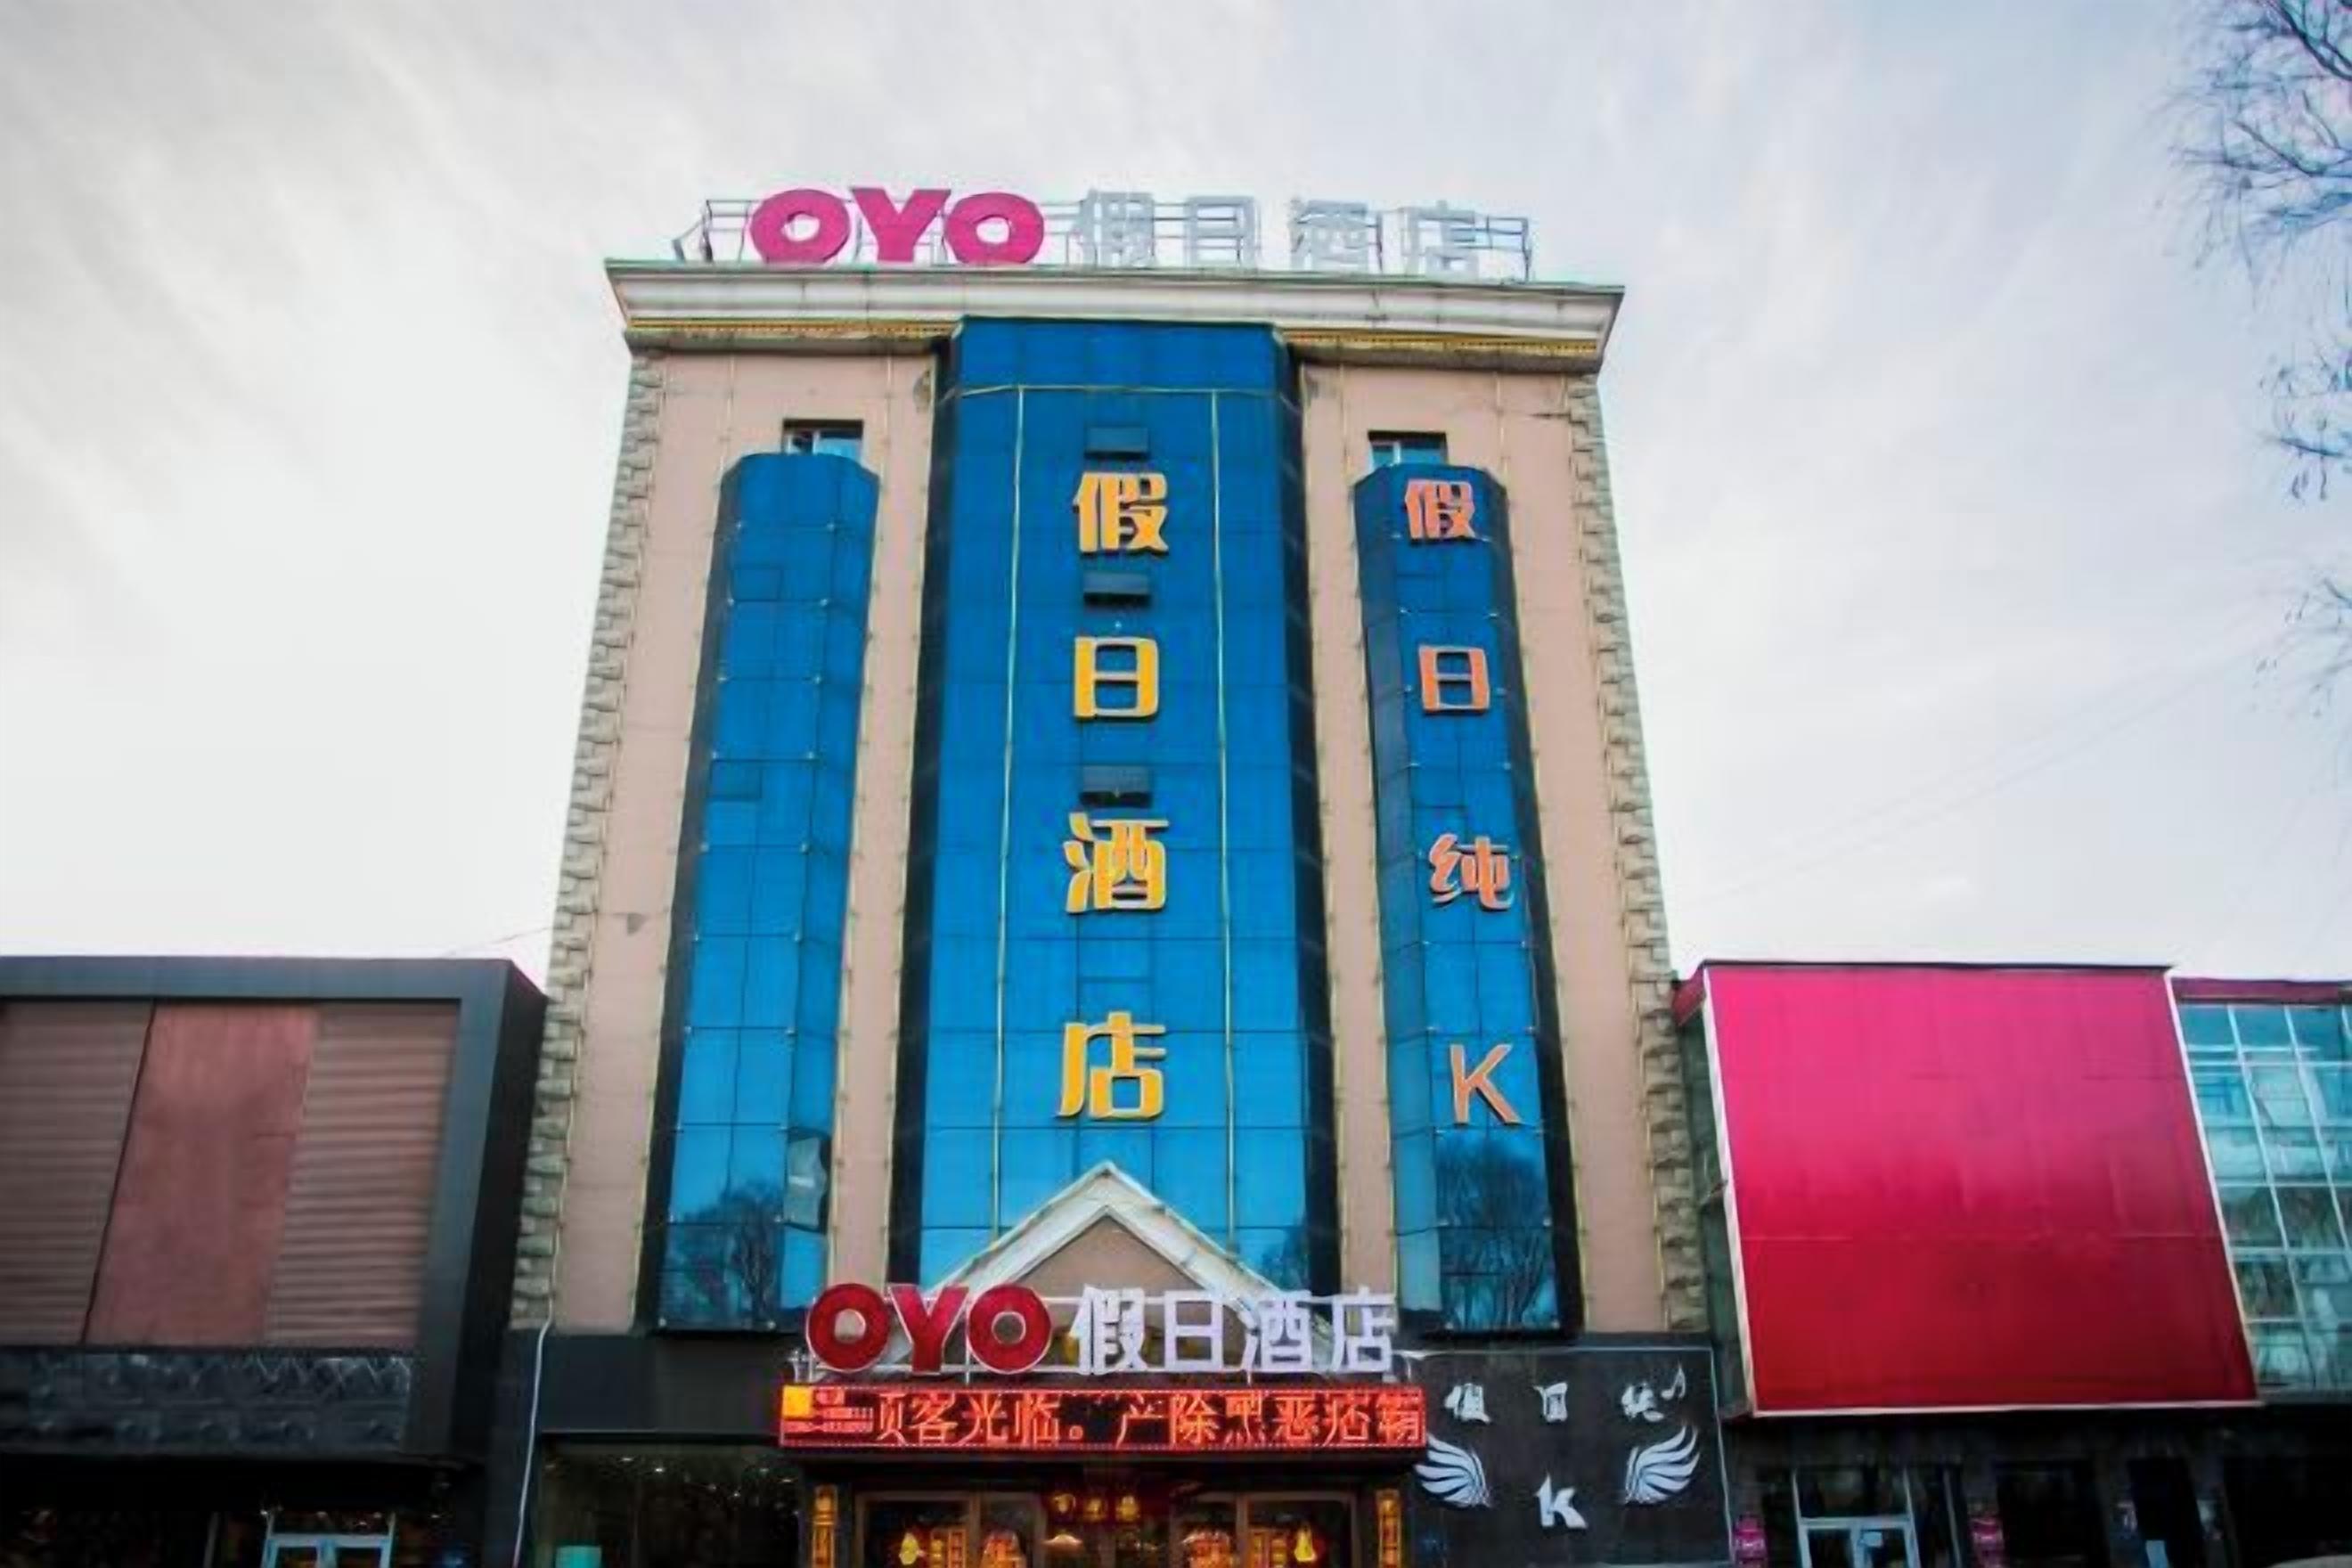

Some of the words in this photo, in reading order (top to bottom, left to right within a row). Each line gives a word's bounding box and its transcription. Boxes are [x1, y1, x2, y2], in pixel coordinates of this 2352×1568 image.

[749, 187, 1044, 265] OYO
[1074, 188, 1477, 276] 假日酒店
[1058, 472, 1170, 1120] 假日酒店
[1405, 478, 1522, 1124] 假日纯K
[805, 1283, 1052, 1374] OYO
[1070, 1284, 1396, 1376] 假日酒店
